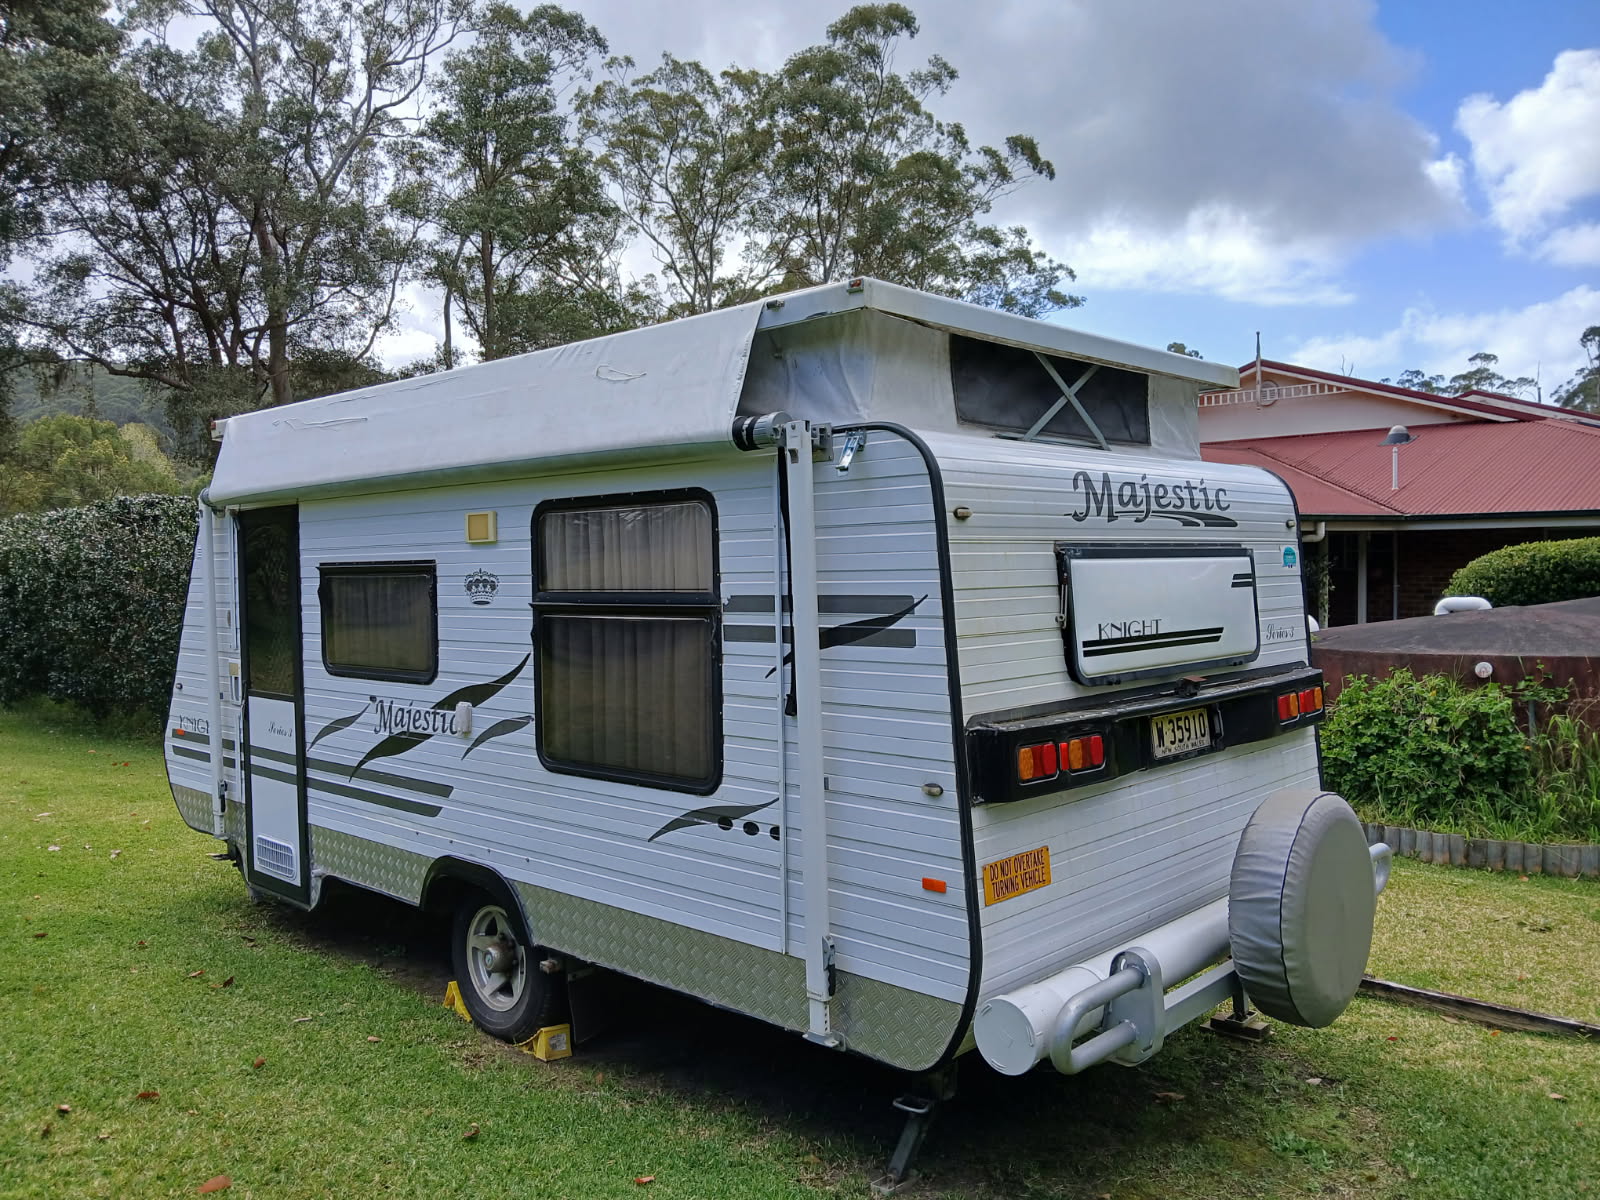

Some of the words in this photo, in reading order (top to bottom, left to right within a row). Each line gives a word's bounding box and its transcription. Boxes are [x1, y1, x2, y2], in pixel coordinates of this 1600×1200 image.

[1072, 470, 1231, 522] Majestic
[1098, 619, 1163, 640] KNIGHT
[1265, 623, 1289, 640] Series
[1289, 626, 1295, 638] 3
[990, 864, 999, 882] DO
[1000, 859, 1012, 878] NOT
[1013, 849, 1045, 874] OVERTAKE
[992, 875, 1020, 899] TURNING
[1020, 866, 1046, 889] VEHICLE
